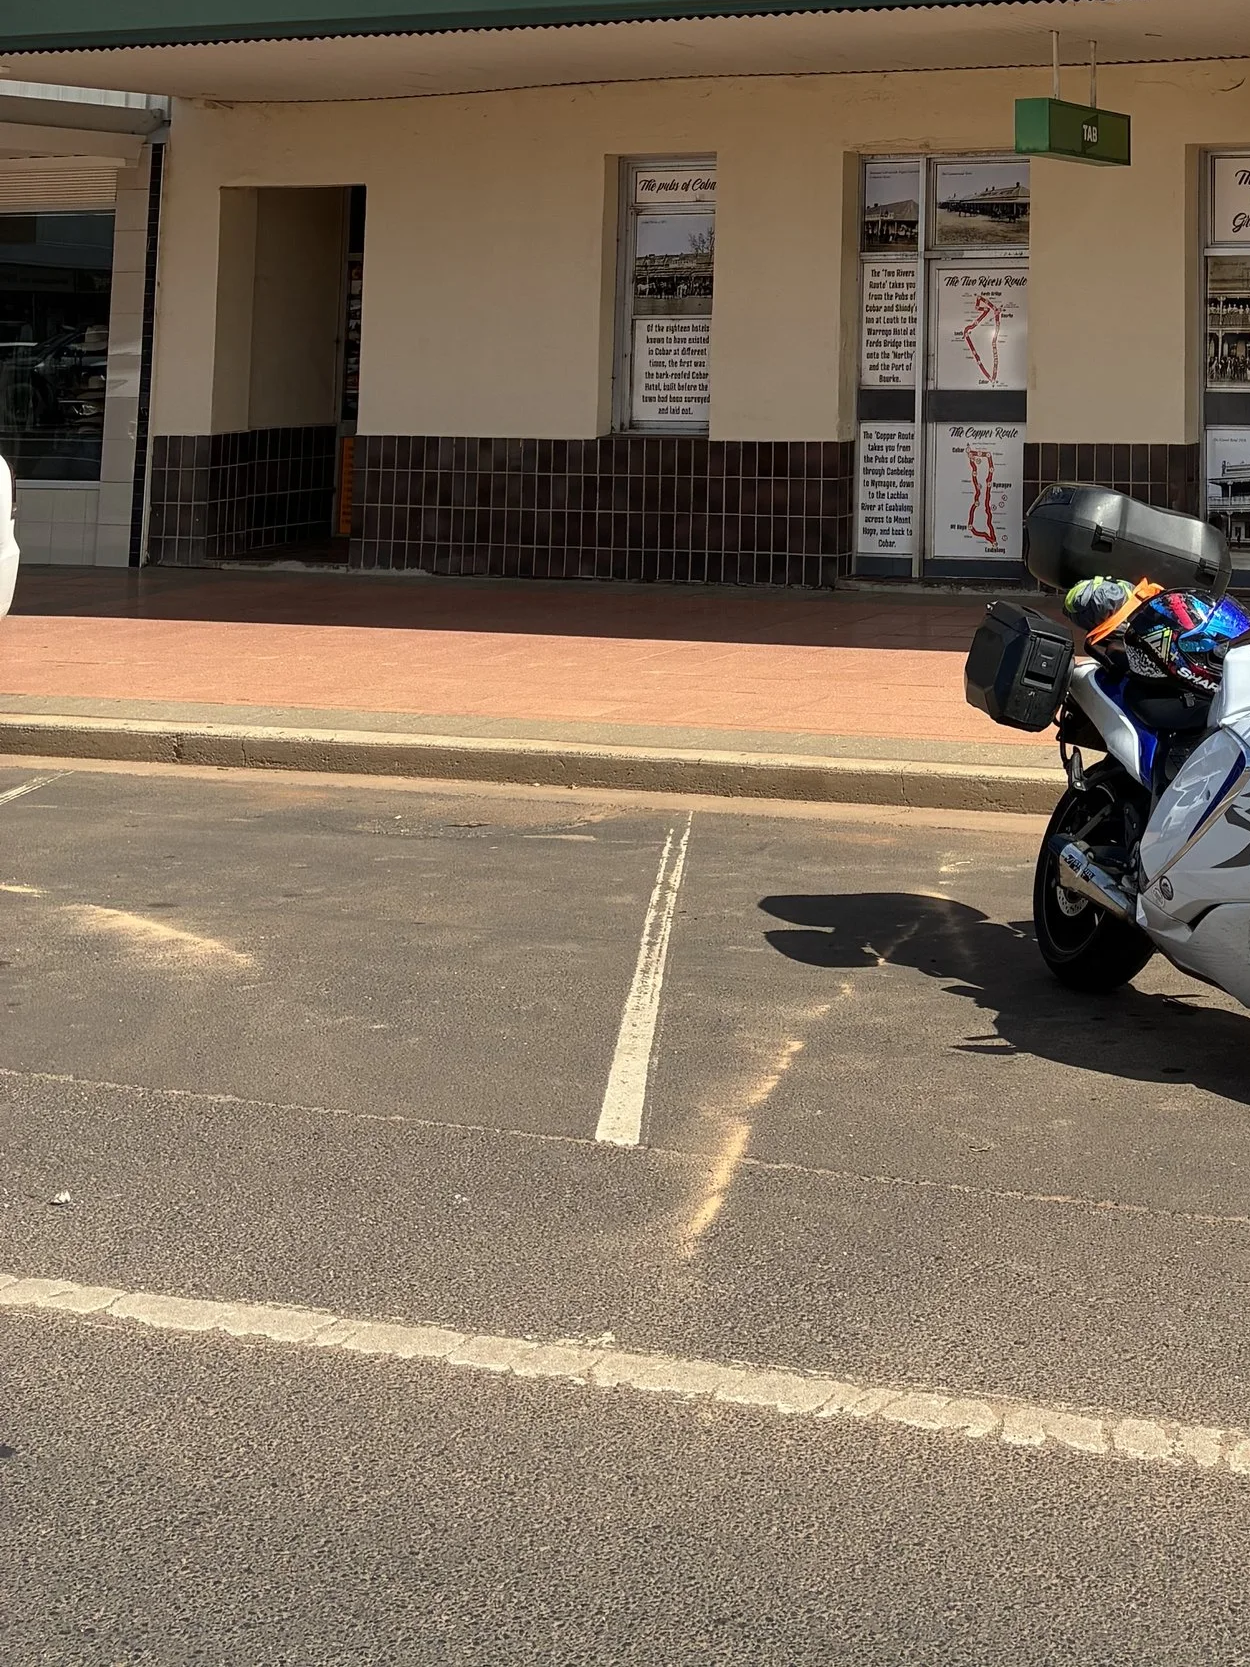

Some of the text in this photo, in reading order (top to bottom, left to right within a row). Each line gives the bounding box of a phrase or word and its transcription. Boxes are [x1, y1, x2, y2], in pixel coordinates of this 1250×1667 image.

[1083, 125, 1097, 142] TAB
[639, 178, 716, 193] The pubs of Coba
[944, 275, 1027, 287] The Two Rivers Route
[949, 427, 1018, 439] The Copper Route
